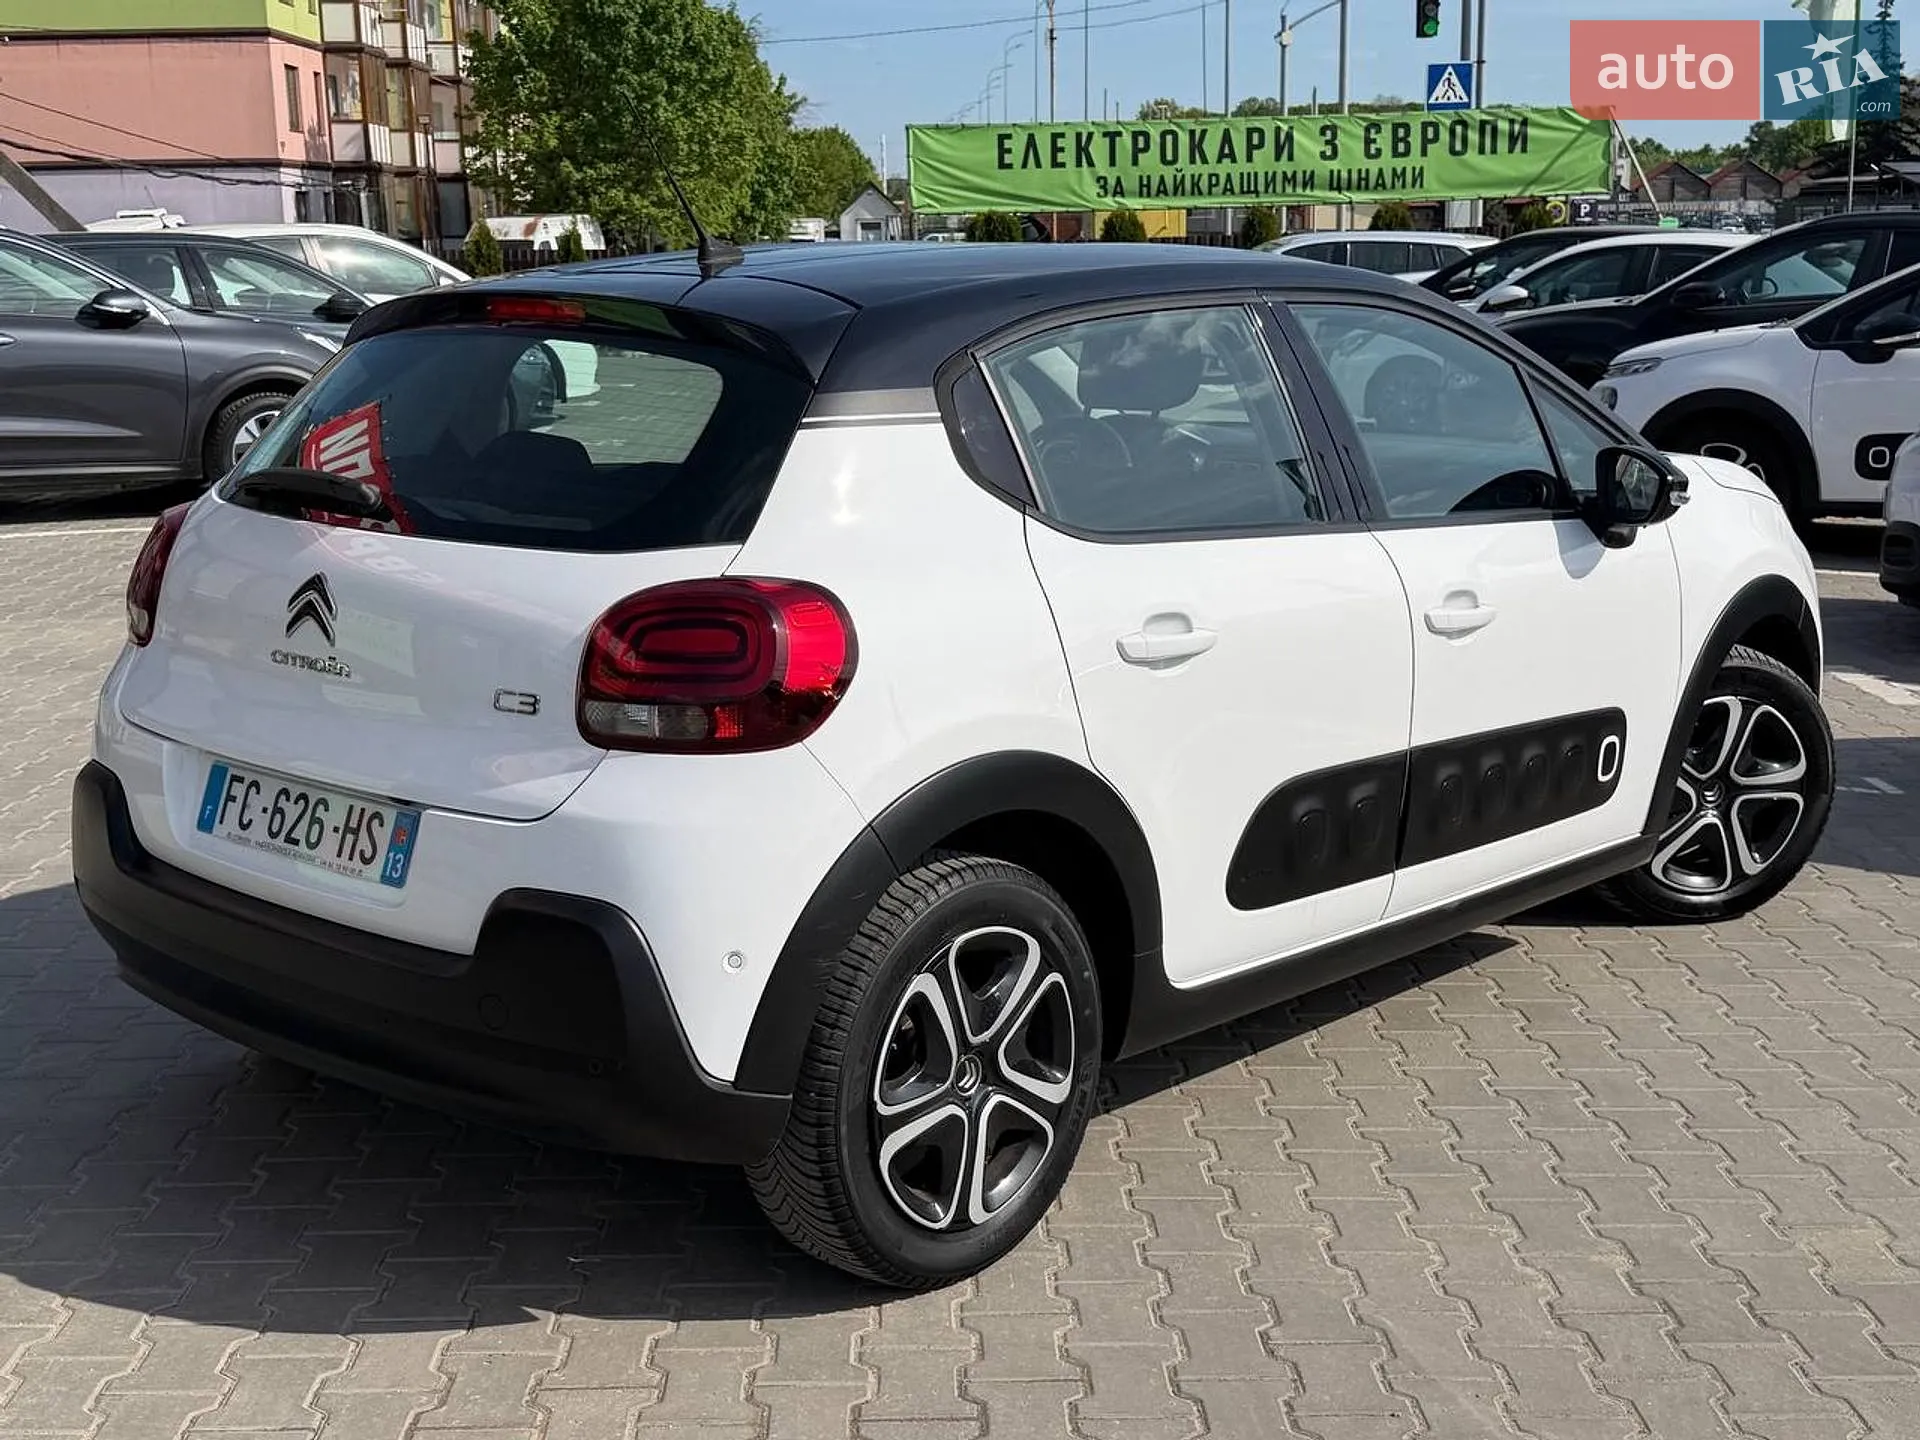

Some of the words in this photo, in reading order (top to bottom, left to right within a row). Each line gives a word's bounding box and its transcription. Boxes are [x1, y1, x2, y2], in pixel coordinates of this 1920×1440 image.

[996, 125, 1296, 170] ЕЛЕКТРОКАРИ
[1319, 124, 1340, 160] З
[1363, 117, 1530, 158] ЄВРОПИ
[1096, 174, 1125, 199] ЗА
[1137, 168, 1315, 198] НАЙКРАЩИМИ
[1328, 165, 1425, 193] ЦІНАМИ
[1580, 204, 1590, 216] P
[270, 649, 351, 678] CITROËN
[493, 689, 541, 716] C3
[204, 808, 212, 820] F
[219, 775, 384, 865] FC-626-HS
[385, 851, 404, 878] 13
